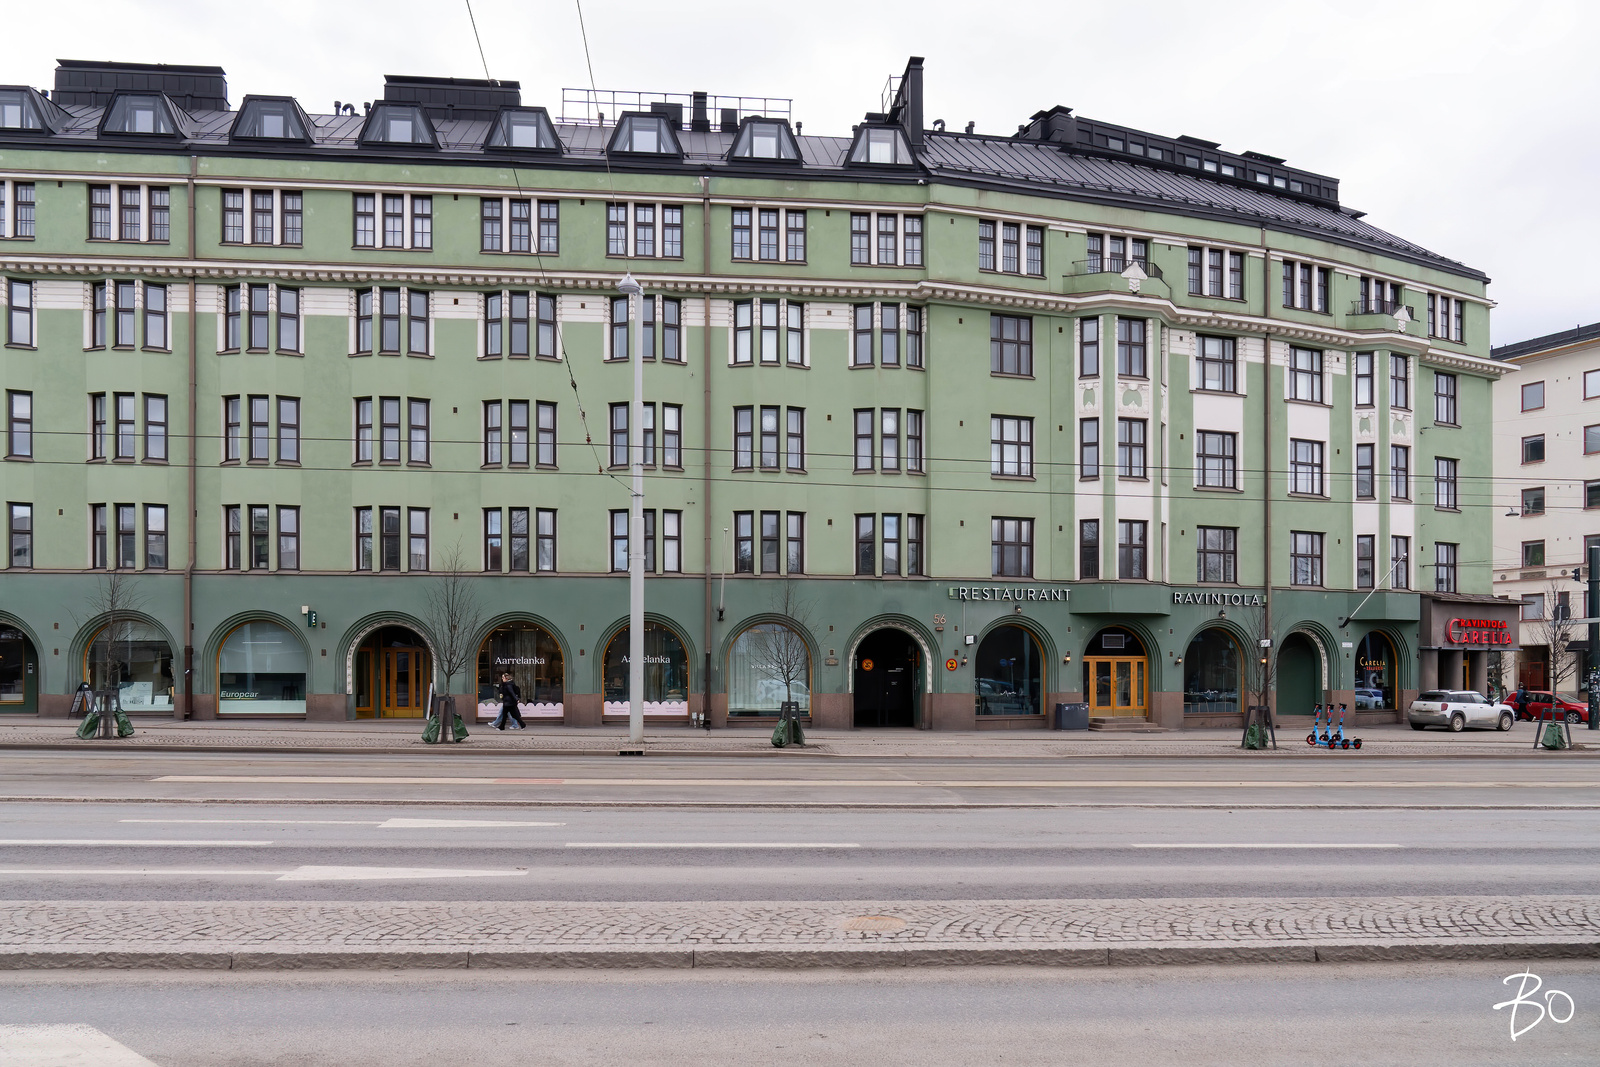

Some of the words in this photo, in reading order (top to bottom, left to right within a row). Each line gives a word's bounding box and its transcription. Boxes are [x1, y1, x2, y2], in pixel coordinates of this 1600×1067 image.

[959, 586, 1071, 601] RESTAURANT
[1173, 592, 1260, 606] RAVINTOLA
[933, 613, 947, 624] 56
[1459, 618, 1507, 628] RAVINTOLA
[1446, 618, 1512, 644] CARELIA
[494, 656, 545, 665] Aarrelanka
[621, 655, 671, 664] Aelanka
[220, 690, 258, 699] Europcar
